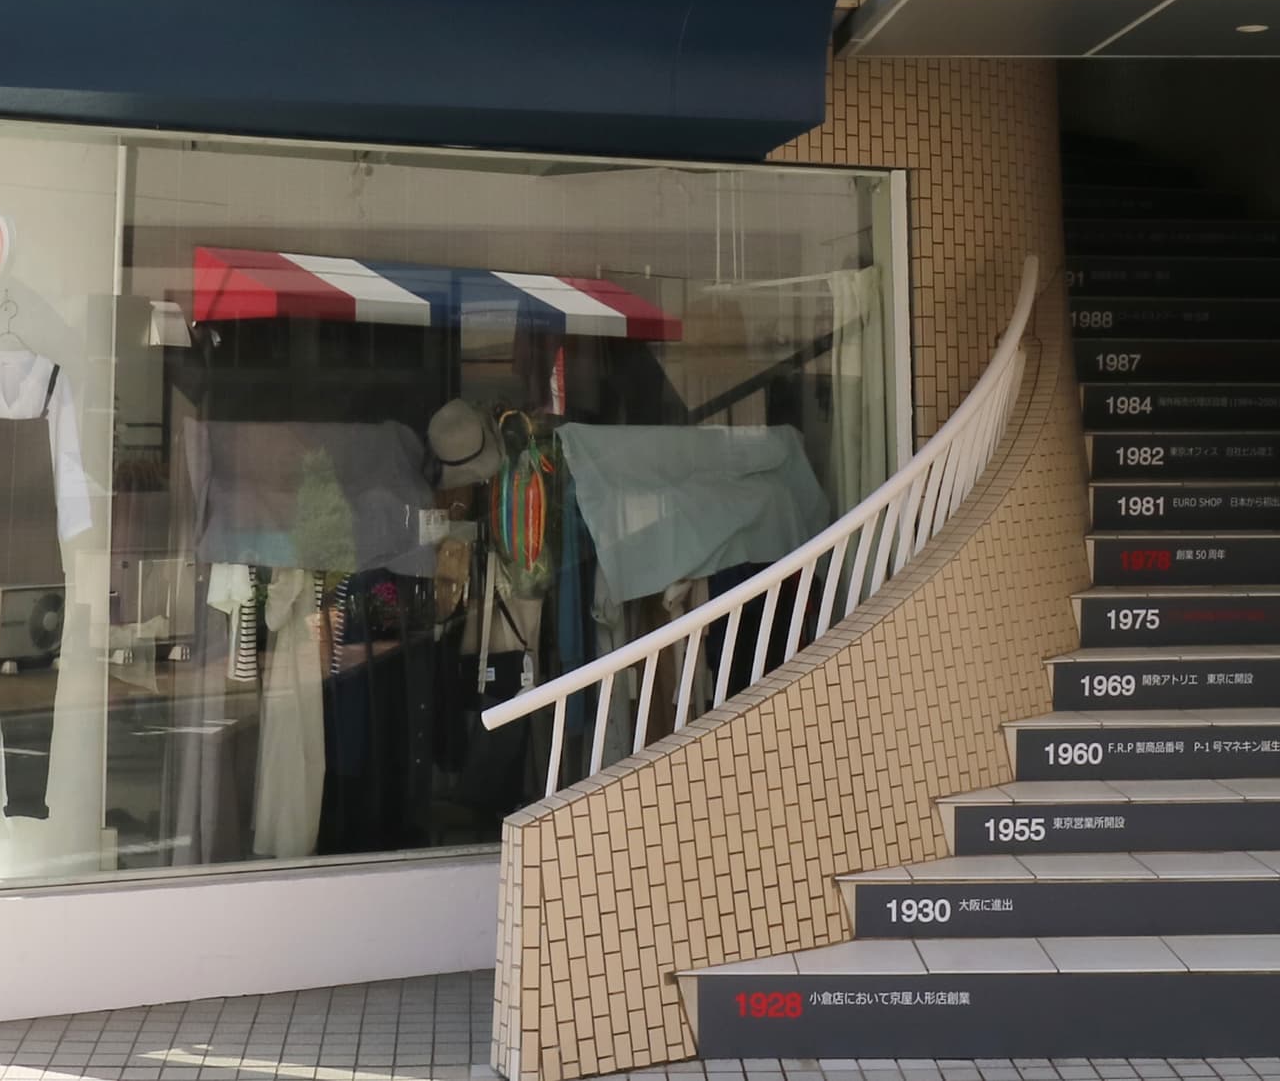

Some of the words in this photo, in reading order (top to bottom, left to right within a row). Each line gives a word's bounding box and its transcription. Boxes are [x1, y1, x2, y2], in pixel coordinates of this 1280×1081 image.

[1070, 311, 1113, 328] 1988
[1095, 353, 1141, 371] 1987
[1105, 396, 1152, 415] 1984
[1115, 447, 1164, 466] 1982
[1117, 497, 1165, 516] 1981
[1173, 497, 1196, 509] EURO
[1199, 497, 1222, 509] SHOP
[1106, 609, 1160, 630] 1975
[1080, 675, 1136, 697] 1969
[1142, 673, 1199, 687] 開発アトリエ
[1207, 673, 1254, 687] 東京に開設
[1044, 742, 1103, 766] 1960
[984, 818, 1045, 842] 1955
[1052, 816, 1125, 830] 東京営業所開設
[886, 899, 950, 923] 1930
[958, 898, 1013, 912] 大阪に進出
[734, 992, 802, 1019] 1928
[809, 991, 970, 1006] 小倉店において京屋人形店創業
